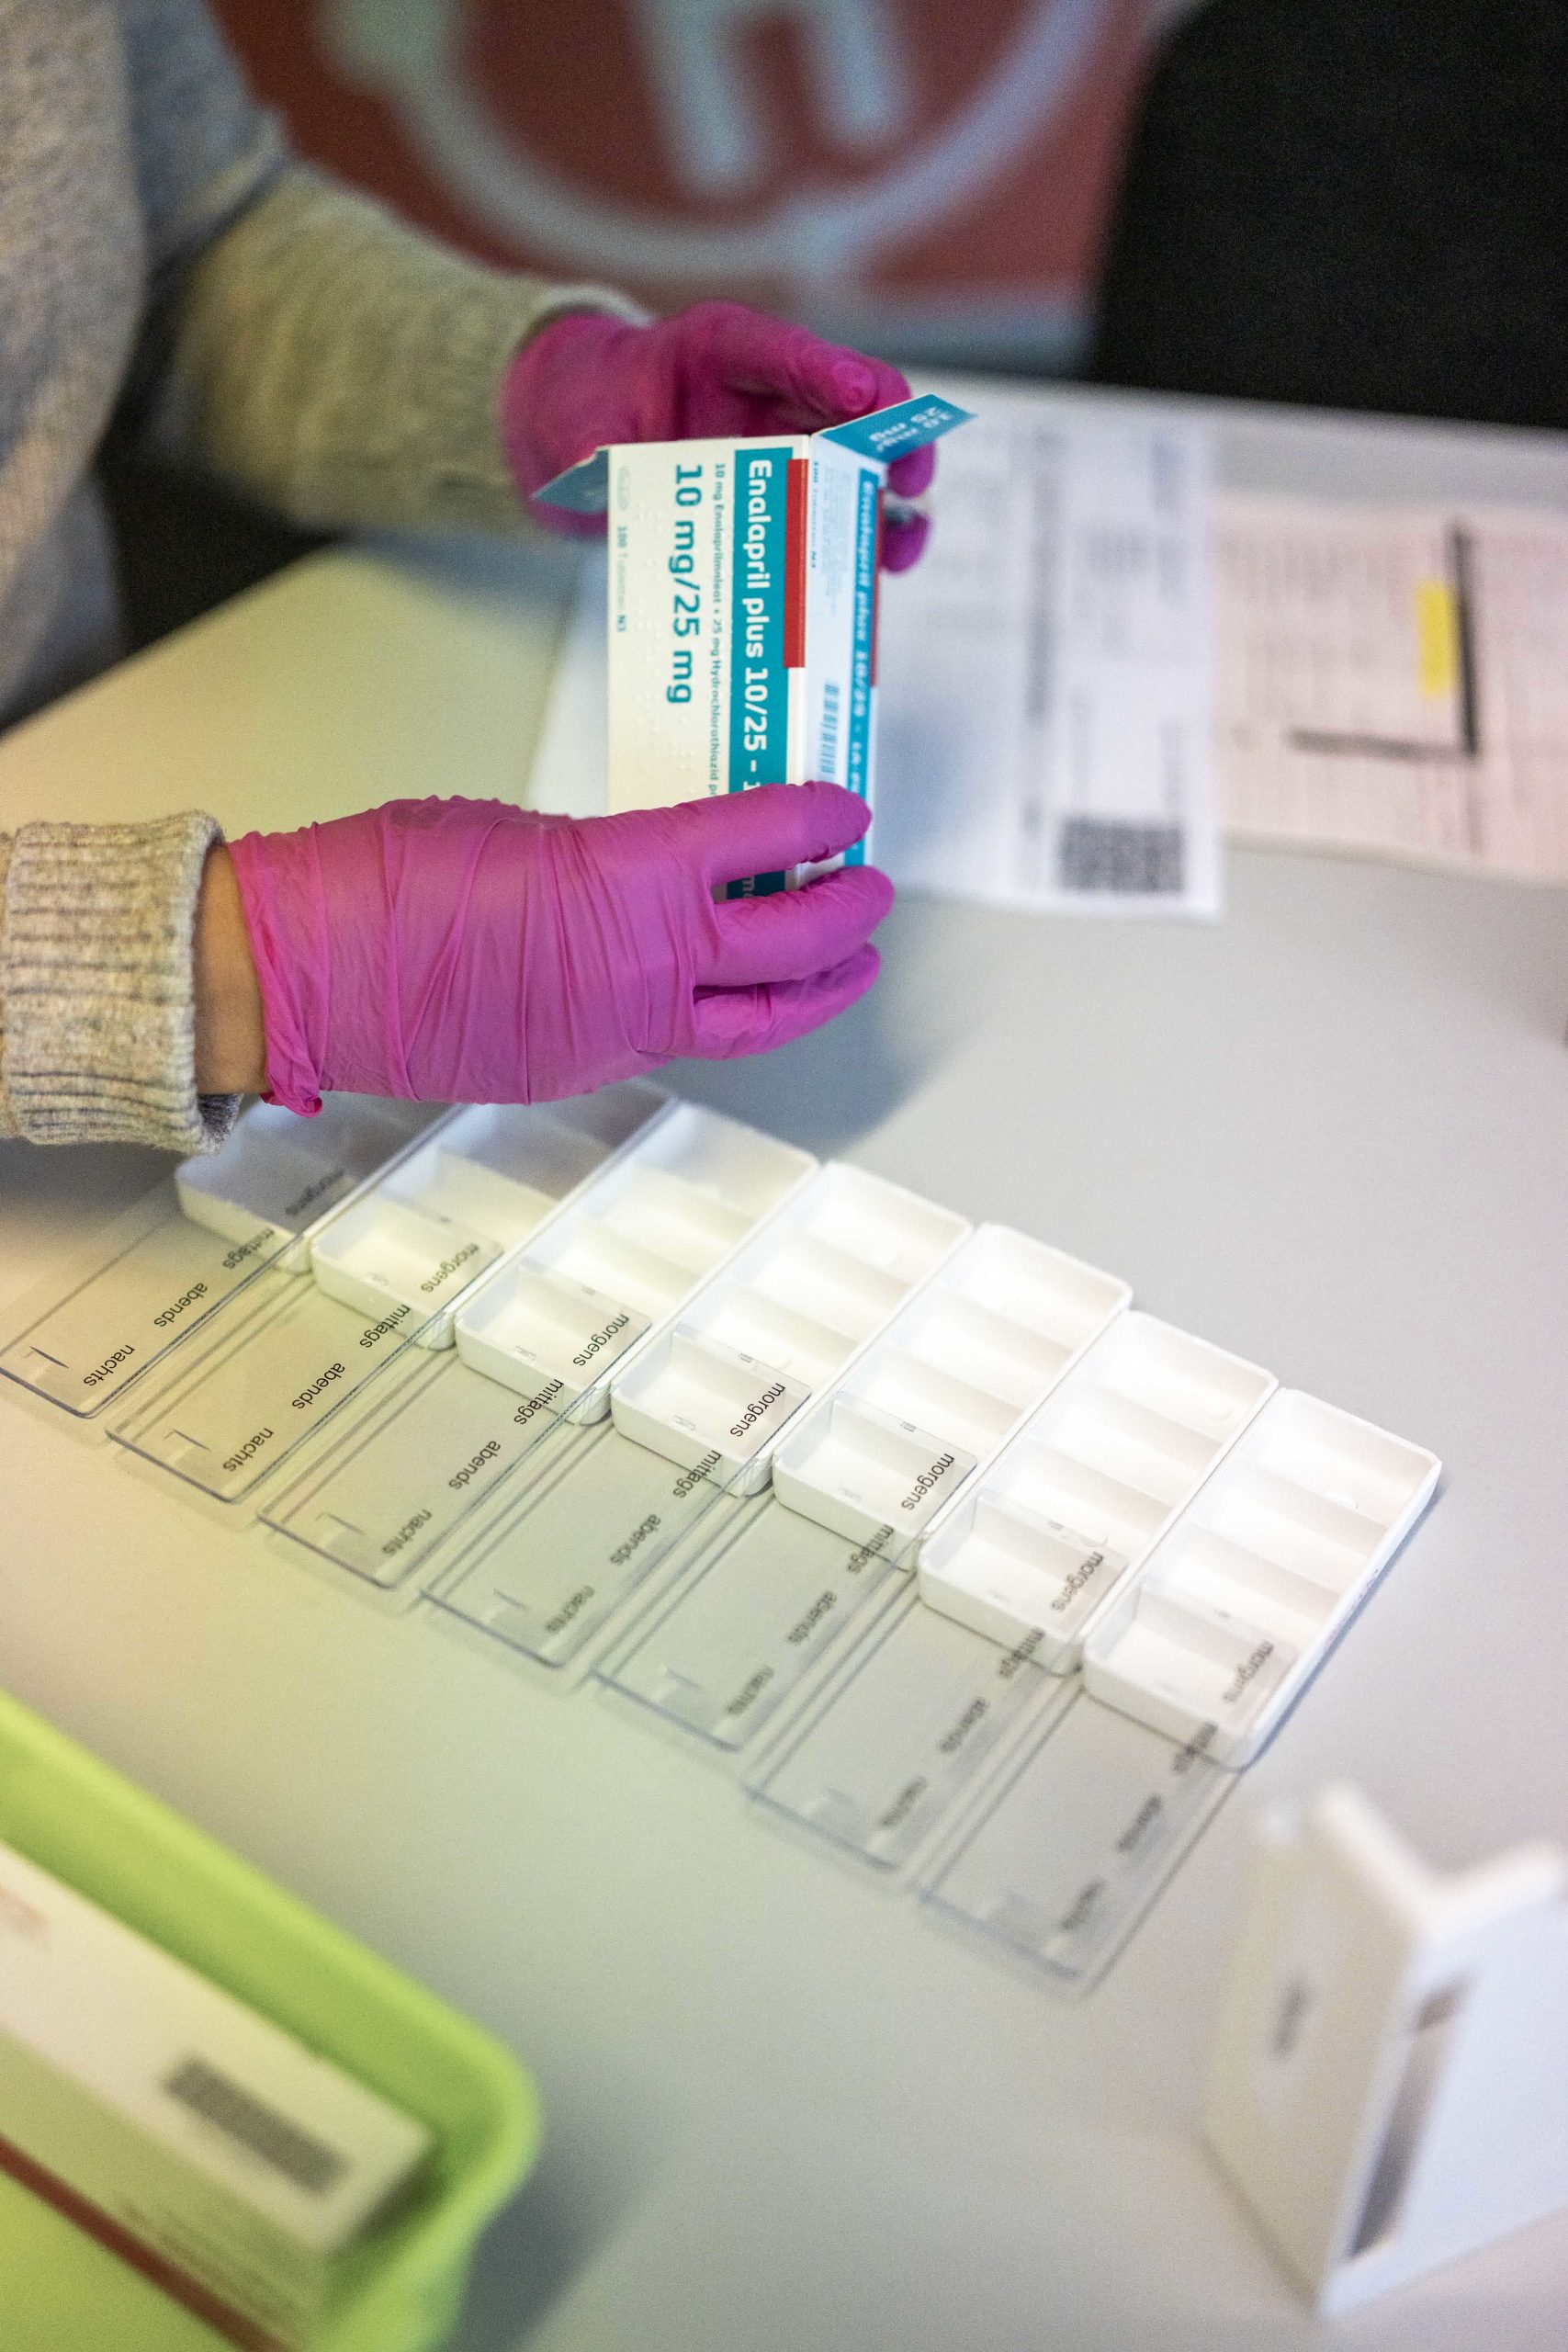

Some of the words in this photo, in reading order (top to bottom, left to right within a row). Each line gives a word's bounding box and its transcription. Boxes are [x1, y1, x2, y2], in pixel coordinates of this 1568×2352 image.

[674, 463, 704, 507] 10
[711, 481, 724, 502] mg
[714, 463, 726, 479] 10
[617, 526, 628, 548] 100
[745, 458, 773, 589] Enalapril
[858, 481, 876, 588] Enalapril
[669, 520, 701, 638] mg/25
[711, 504, 726, 604] Enalaprilmaleat
[712, 618, 723, 634] 25
[741, 598, 769, 659] plus
[856, 591, 870, 642] plus
[710, 637, 721, 657] mg
[666, 650, 694, 705] mg
[708, 660, 722, 781] Hydrochlorothiazid
[743, 667, 768, 752] 10/25
[222, 1227, 275, 1270] mittags
[420, 1241, 480, 1295] morgens
[153, 1283, 209, 1329] abends
[359, 1304, 411, 1349] mittags
[83, 1344, 135, 1387] nachts
[572, 1314, 630, 1368] morgens
[291, 1363, 346, 1411] abends
[513, 1379, 565, 1426] mittags
[729, 1383, 787, 1439] morgens
[223, 1427, 275, 1473] nachts
[448, 1440, 502, 1491] abends
[672, 1450, 723, 1499] mittags
[900, 1453, 955, 1511] morgens
[381, 1509, 434, 1555] nachts
[609, 1514, 663, 1566] abends
[847, 1524, 896, 1575] mittags
[1050, 1551, 1104, 1614] morgens
